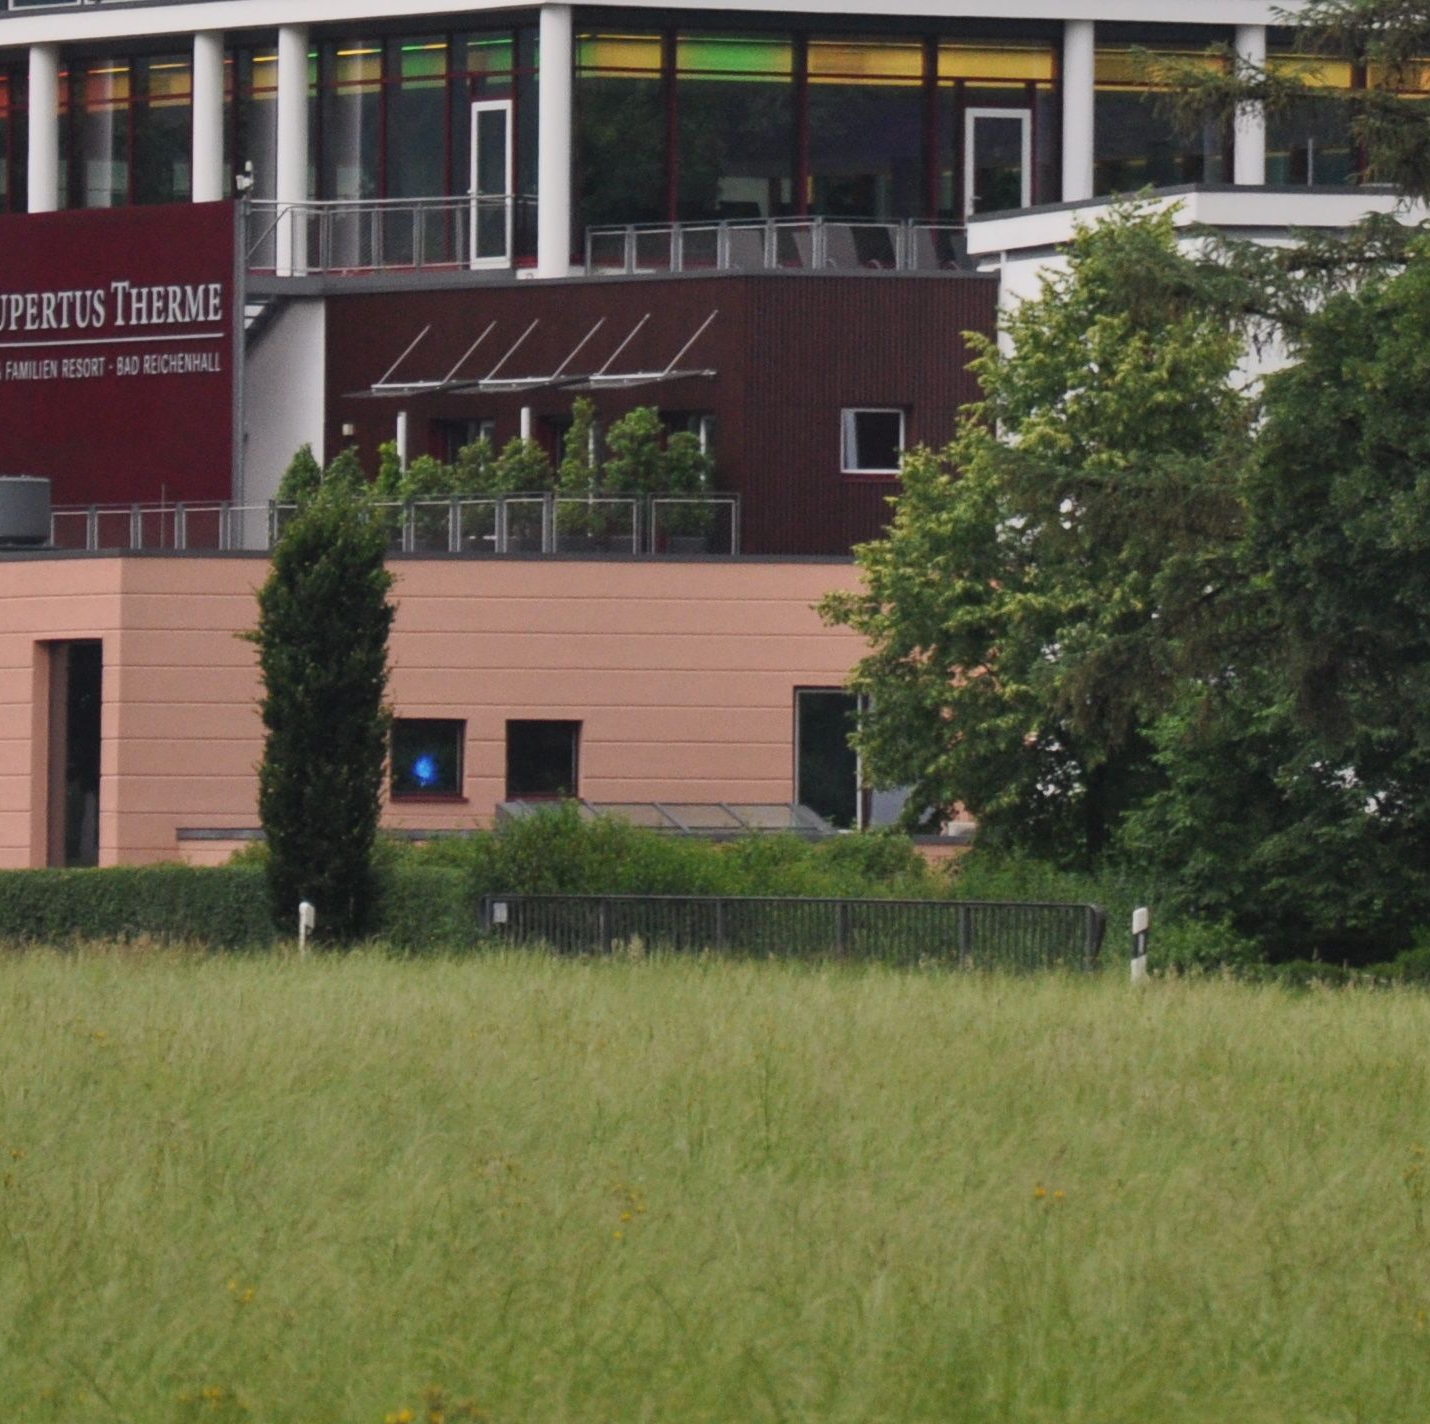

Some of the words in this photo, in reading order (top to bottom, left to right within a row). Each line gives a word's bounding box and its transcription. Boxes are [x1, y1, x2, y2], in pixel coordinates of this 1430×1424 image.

[111, 280, 222, 326] THERME
[5, 359, 58, 380] FAMILIEN
[62, 357, 106, 378] RESORT
[116, 356, 140, 376] BAD
[143, 352, 221, 375] REICHENHALL
